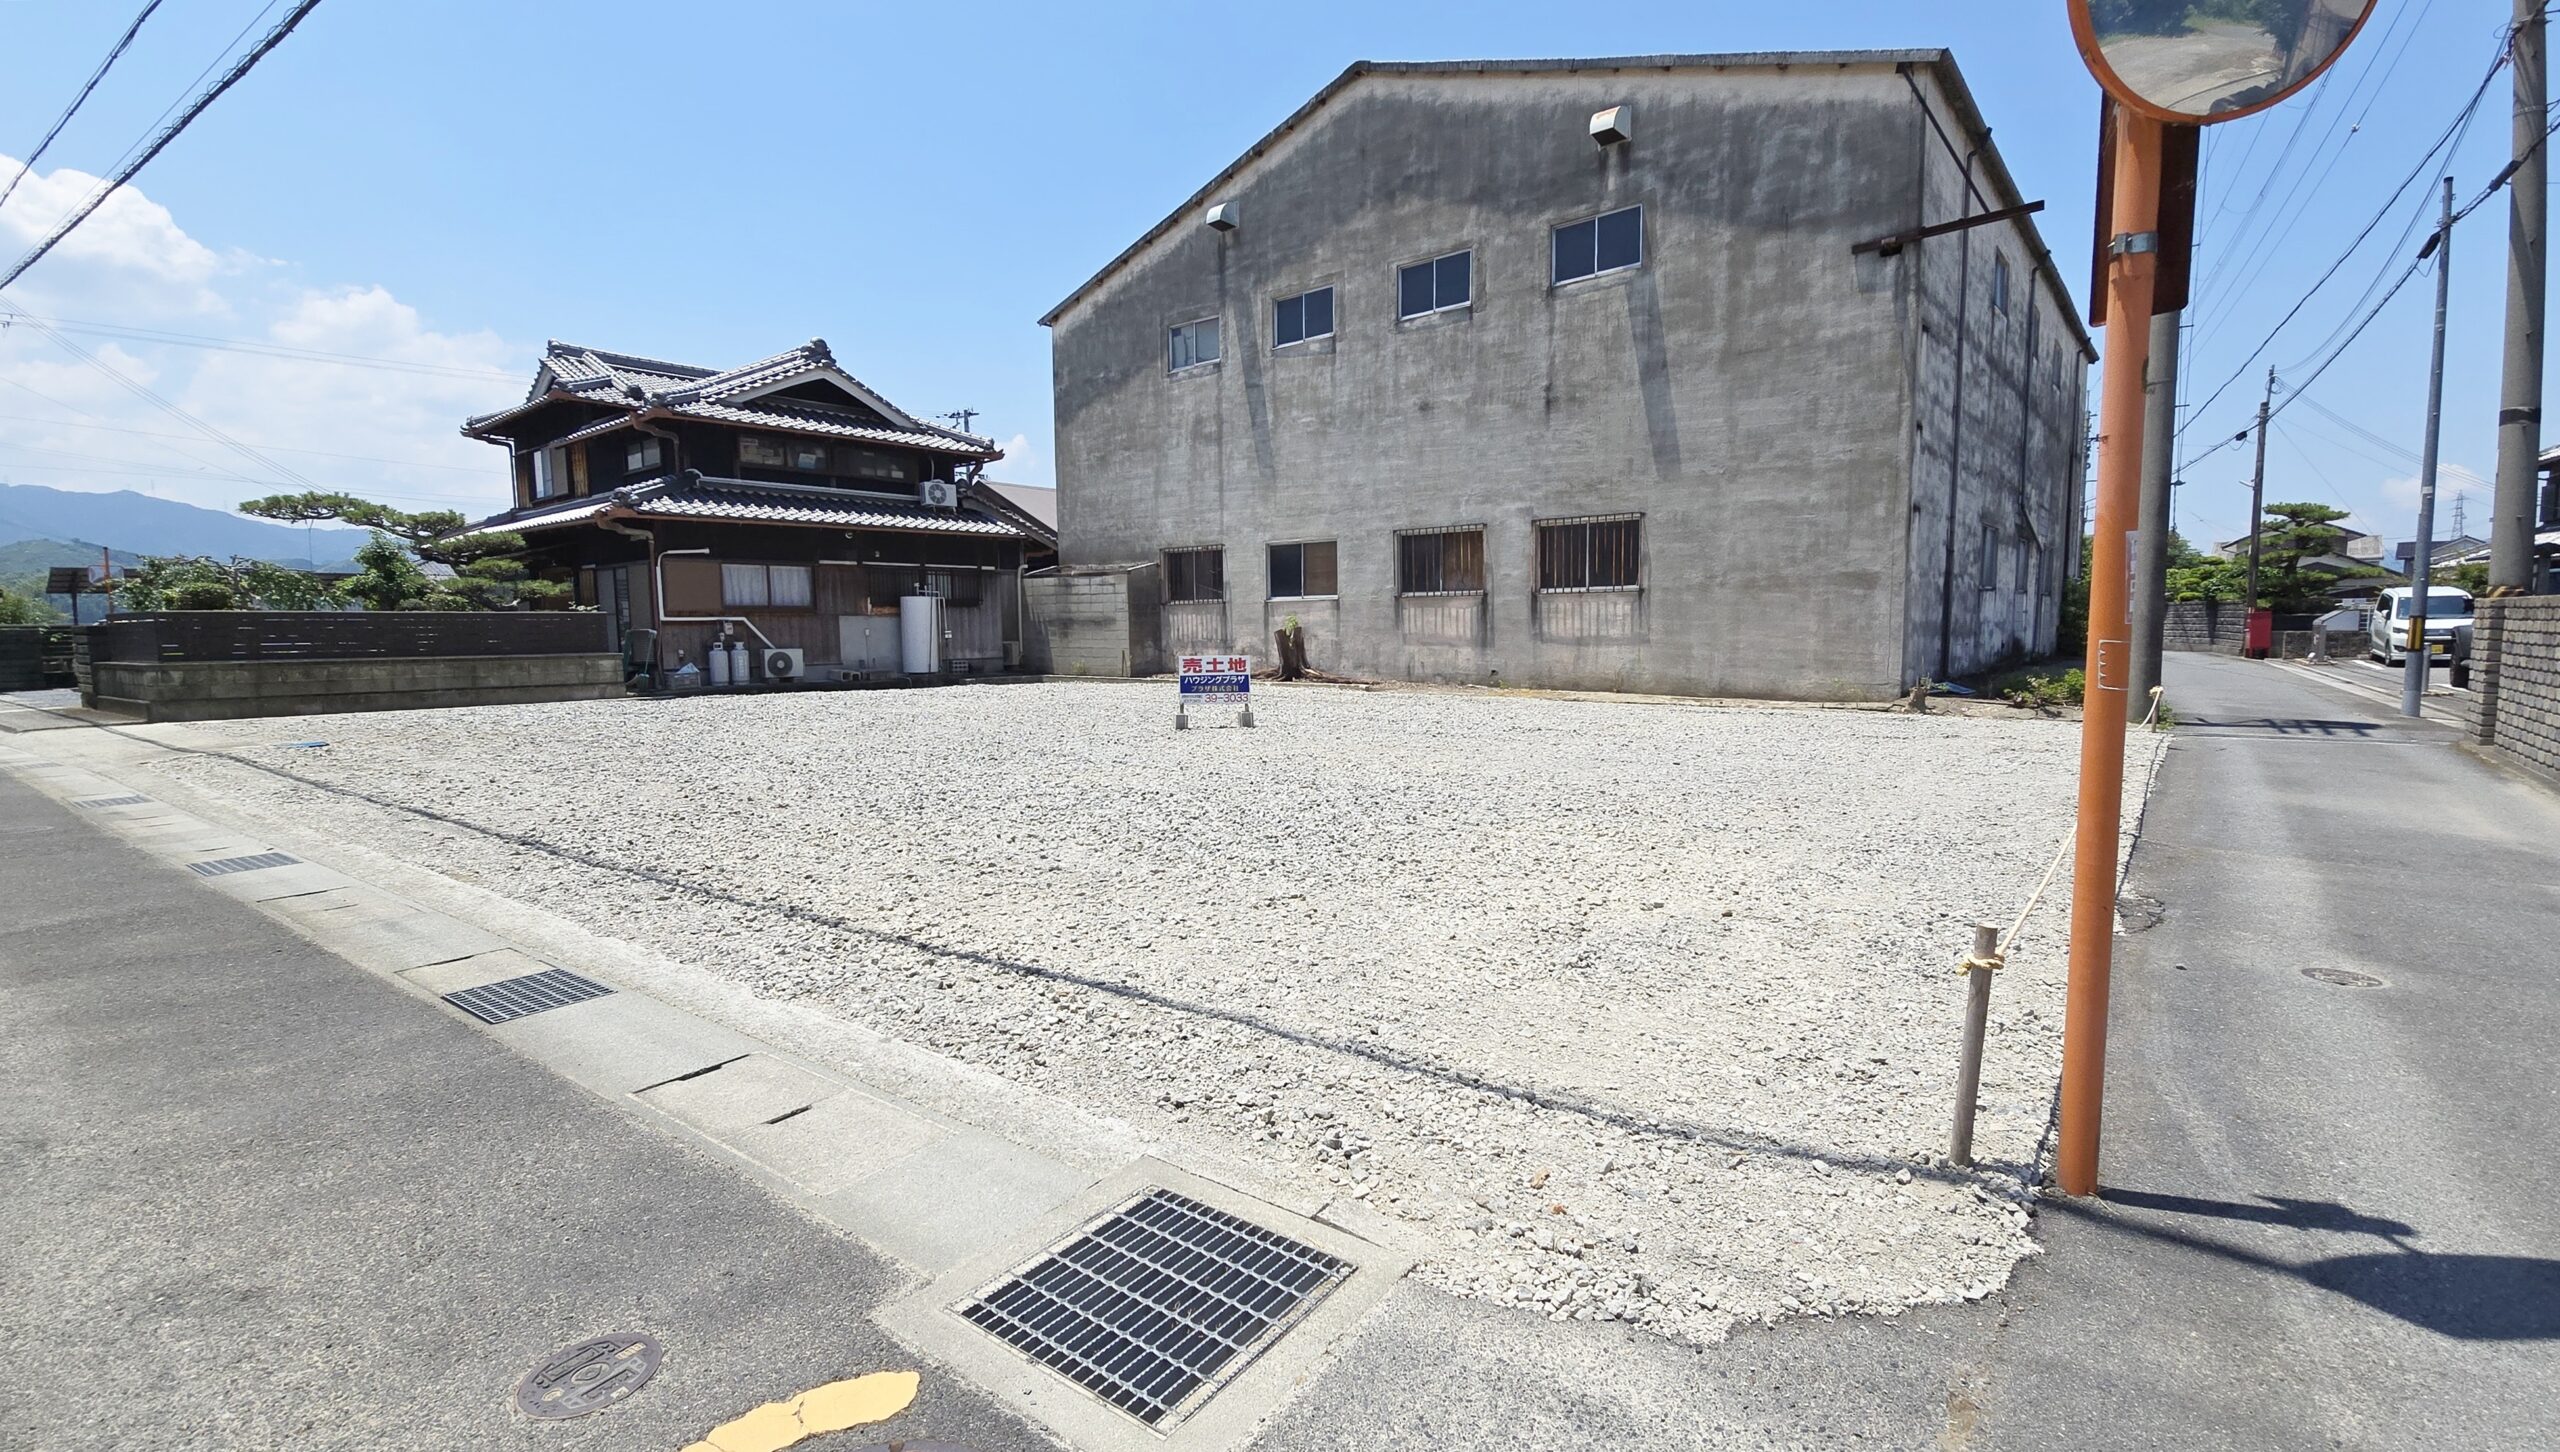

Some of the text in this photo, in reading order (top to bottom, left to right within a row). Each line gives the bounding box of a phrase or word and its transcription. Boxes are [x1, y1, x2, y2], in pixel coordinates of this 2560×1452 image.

[1182, 657, 1247, 674] 売土地
[1184, 675, 1245, 684] ハウジングプラザ
[1204, 693, 1249, 703] 39-3033
